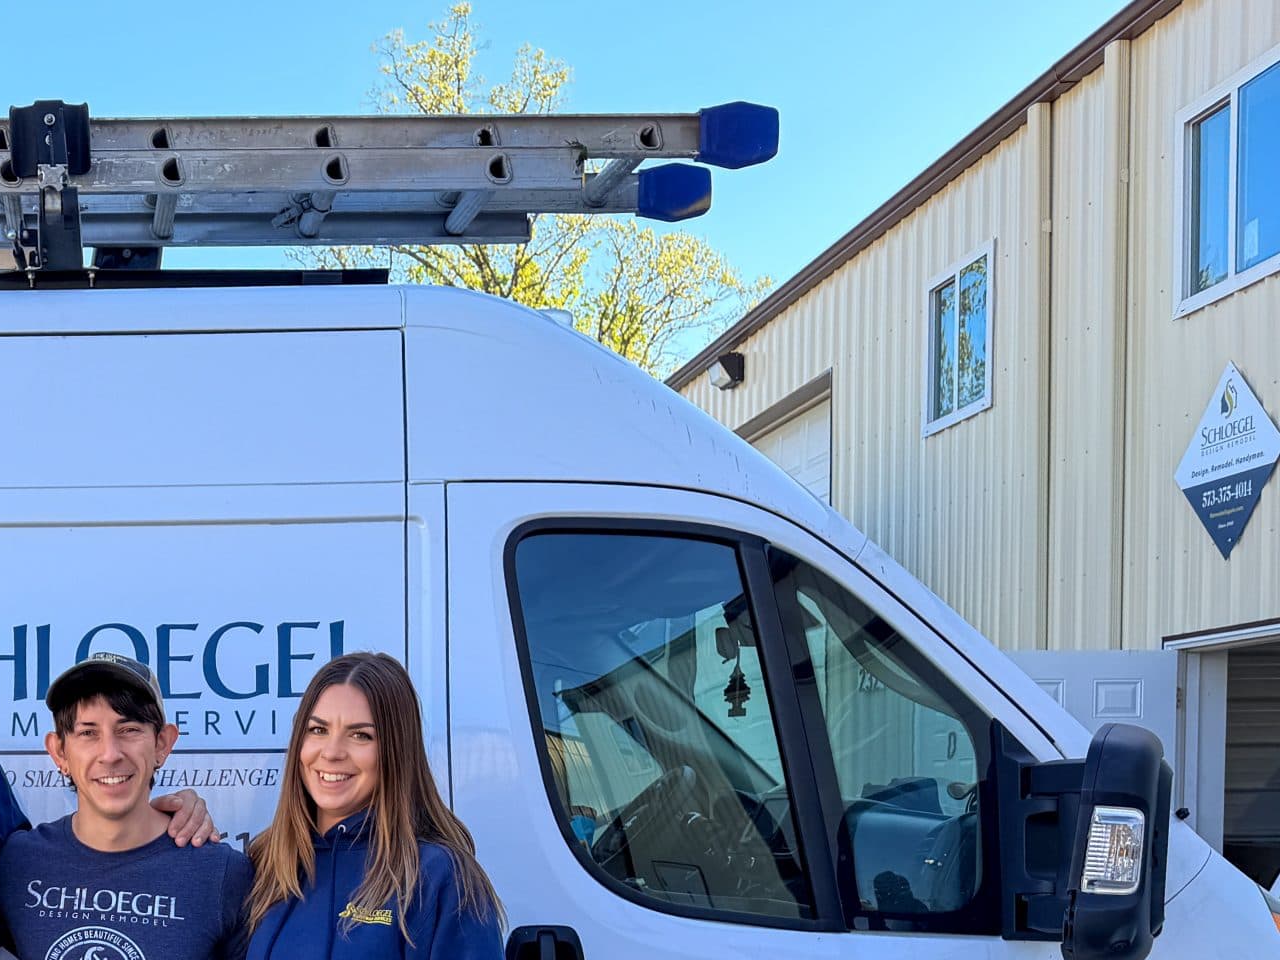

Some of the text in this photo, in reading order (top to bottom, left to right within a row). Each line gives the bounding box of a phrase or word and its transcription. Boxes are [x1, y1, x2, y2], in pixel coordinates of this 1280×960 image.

[1201, 415, 1256, 447] SCHLOEGEL
[1201, 434, 1256, 457] DESIGN REMODEL
[25, 879, 185, 920] SCHLOEGEL
[39, 910, 169, 928] DESIGN REMODEL
[58, 931, 84, 950] HOMES
[84, 930, 122, 946] BEAUTIFUL
[121, 942, 140, 960] SINCE
